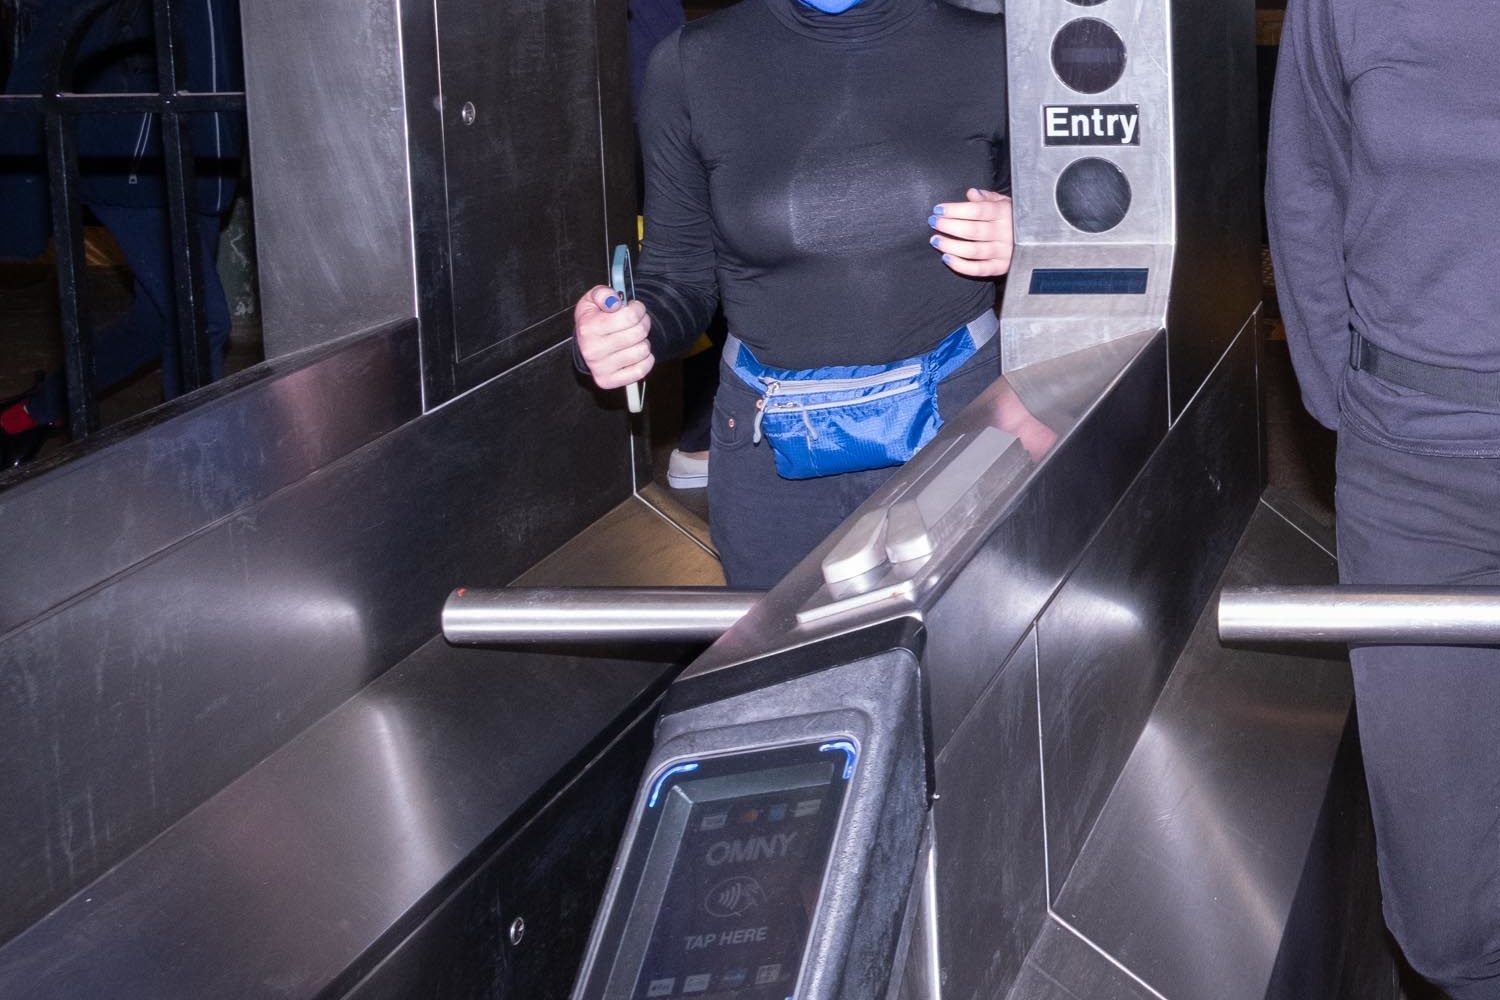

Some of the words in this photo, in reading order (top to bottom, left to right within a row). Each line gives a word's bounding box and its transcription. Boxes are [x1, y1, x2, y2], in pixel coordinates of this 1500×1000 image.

[1046, 107, 1138, 144] Entry
[706, 832, 798, 867] OMNY
[685, 932, 716, 951] TAP
[719, 926, 768, 946] HERE
